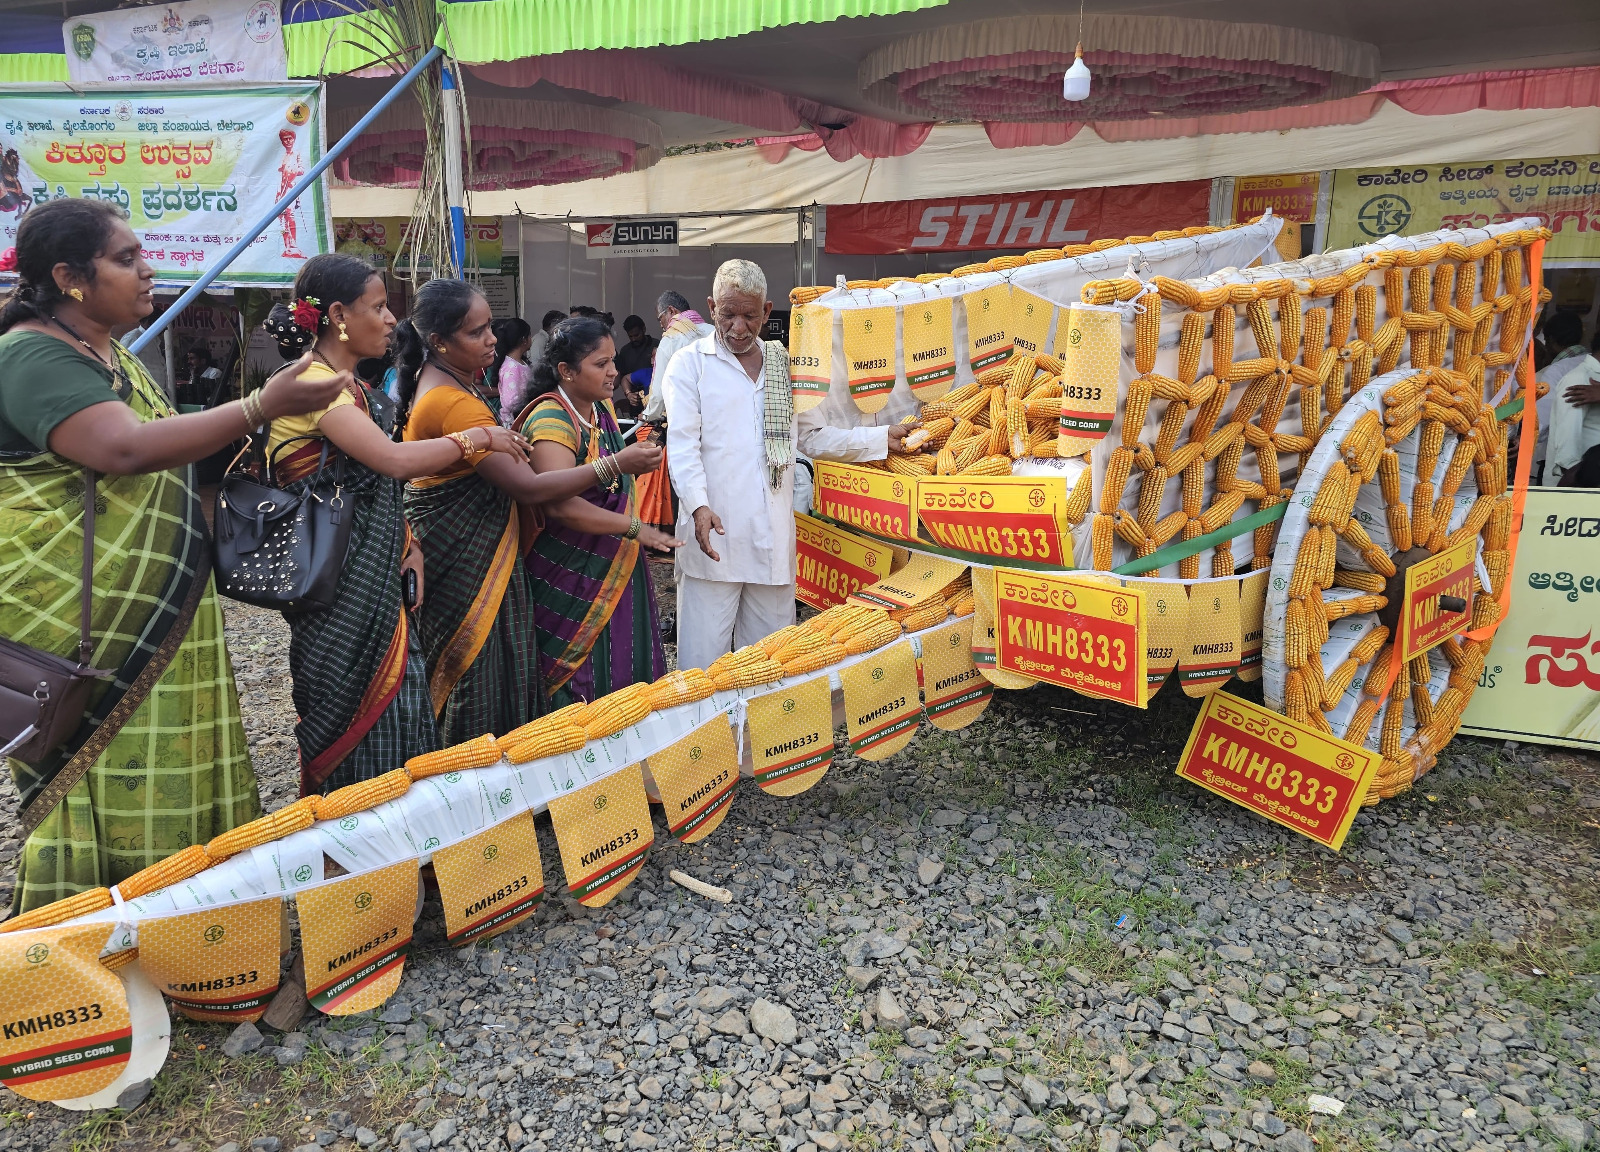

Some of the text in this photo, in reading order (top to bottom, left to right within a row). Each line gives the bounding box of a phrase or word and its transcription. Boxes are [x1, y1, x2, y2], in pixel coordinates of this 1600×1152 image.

[1356, 168, 1429, 187] ಕಾವೇರಿ
[1438, 163, 1494, 183] ಸೀಡ್
[1505, 158, 1578, 179] ಕಂಪನಿ
[142, 182, 238, 221] ಪ್ರದರ್ಶನ
[1242, 194, 1307, 212] KMH8333
[1547, 181, 1600, 196] ಬಾಂಧ
[911, 198, 1093, 249] STIHL
[912, 346, 947, 363] KMH8333
[1063, 385, 1102, 401] H8333
[822, 471, 870, 494] ಕಾವೇರಿ
[924, 486, 995, 510] ಕಾವೇರಿ
[825, 500, 908, 540] KMH8333
[931, 521, 1051, 559] KMH8333
[1415, 557, 1453, 588] ಕಾವೇರಿ
[1003, 581, 1077, 610] ಕಾವೇರಿ
[1007, 614, 1127, 672] KMH8333
[1192, 642, 1234, 656] KMH8333
[935, 667, 982, 692] KMH8333
[858, 696, 906, 726] KMH8333
[1216, 704, 1298, 750] ಕಾವೇರಿ
[765, 732, 820, 758] KMH8333
[1202, 731, 1338, 814] KMH8333
[680, 769, 729, 812] KMH8333
[580, 828, 639, 868] KMH8333
[465, 875, 529, 919] KMH8333
[585, 874, 610, 892] HYBRID
[465, 921, 492, 938] HYBRID
[493, 912, 512, 925] SEED
[327, 927, 398, 973] KMH8333
[167, 970, 259, 993] KMH8333
[326, 951, 398, 998] HYBRID SEED CORN
[232, 999, 259, 1010] CORN
[3, 1003, 104, 1040] KMH8333
[12, 1044, 115, 1075] HYBRID SEED CORN
